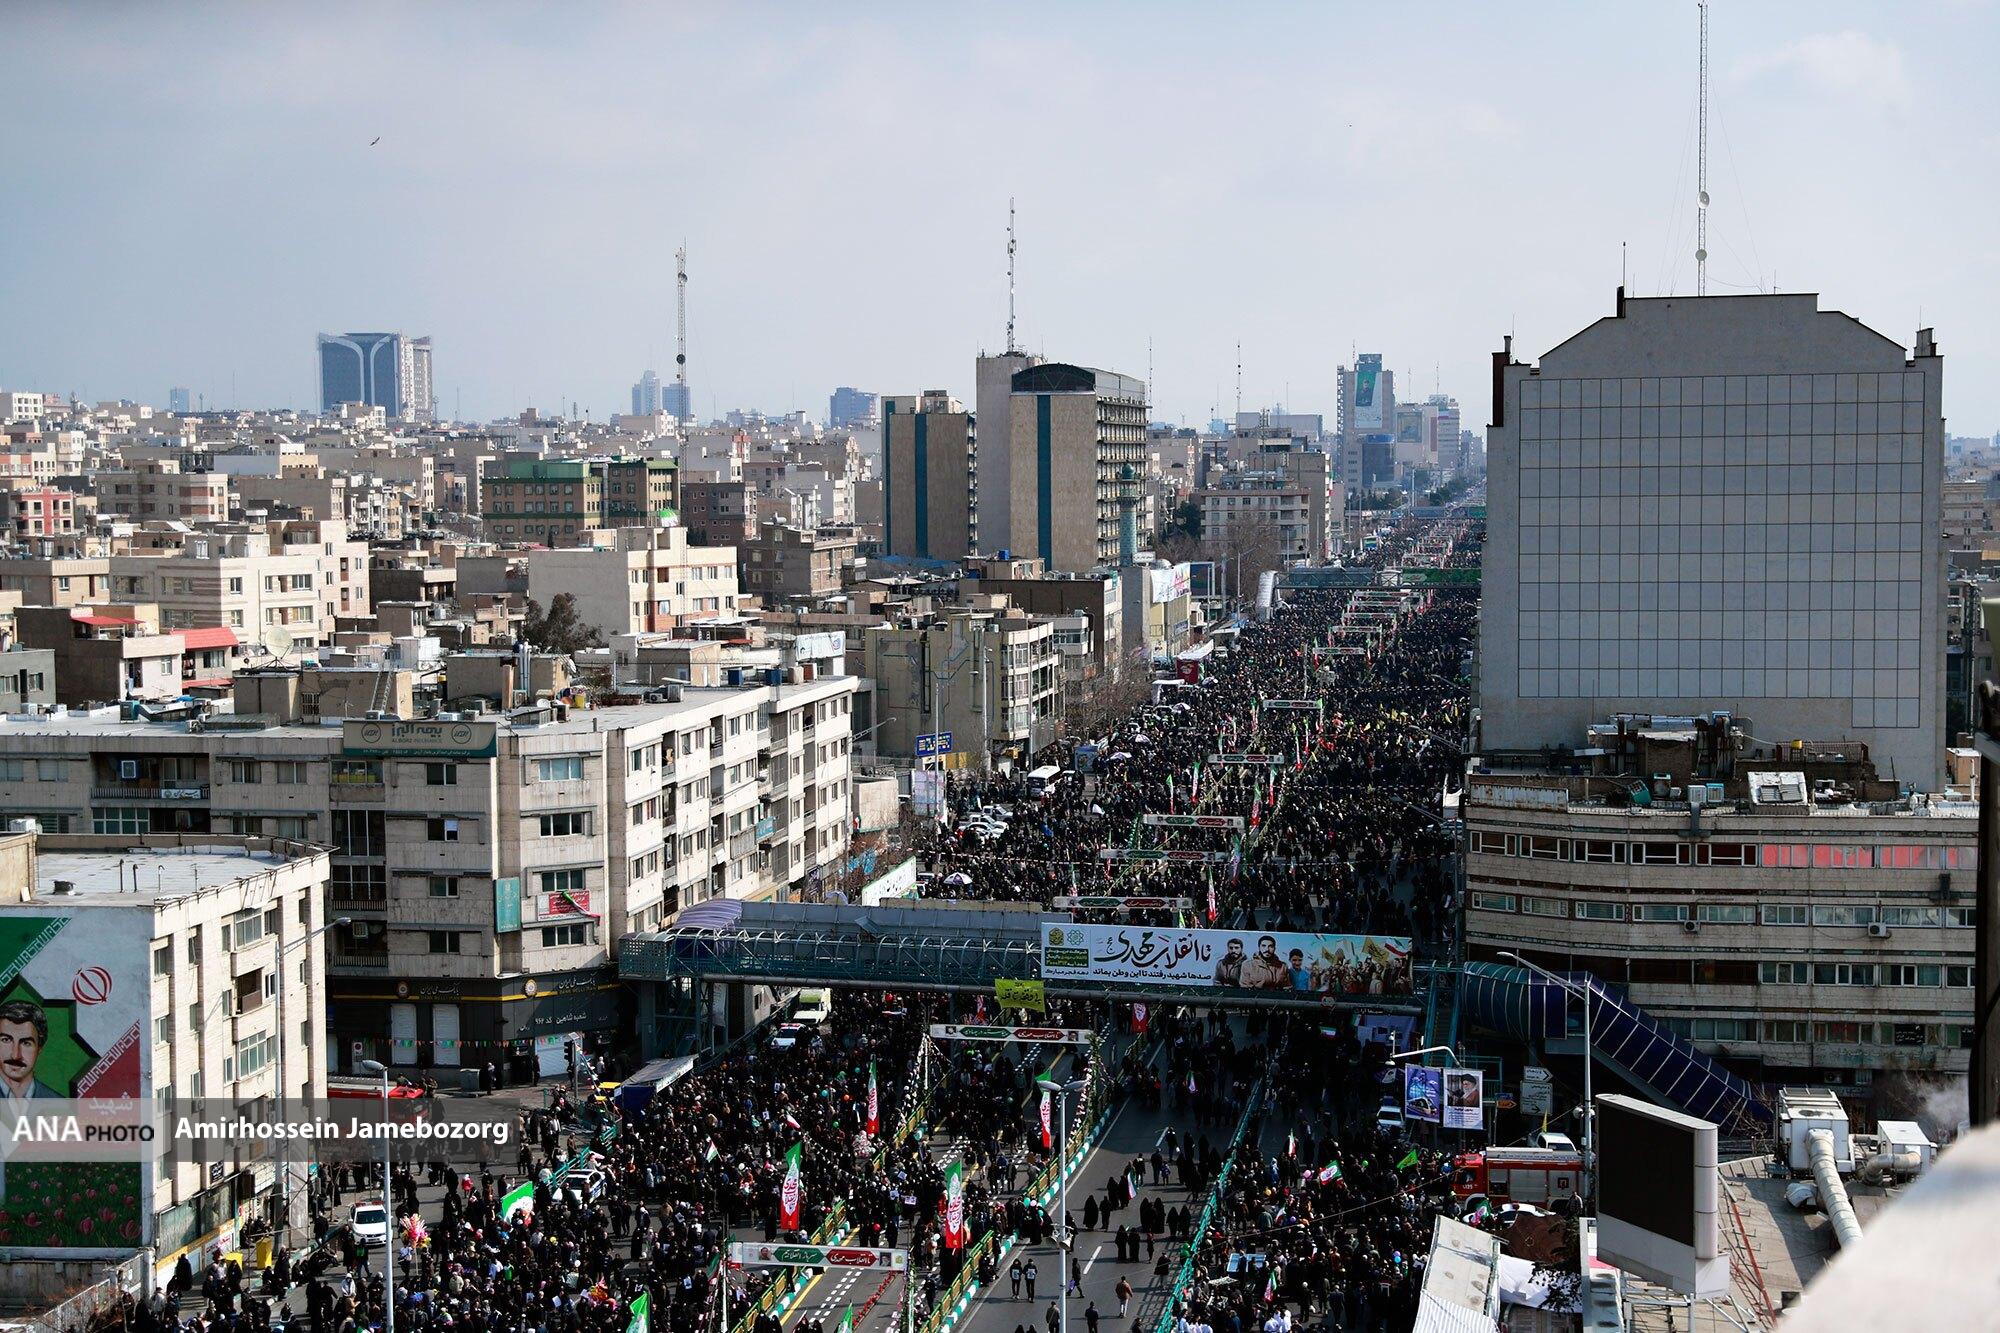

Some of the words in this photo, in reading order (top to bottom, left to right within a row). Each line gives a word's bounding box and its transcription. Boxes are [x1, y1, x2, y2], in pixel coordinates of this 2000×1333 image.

[391, 723, 415, 738] البرز
[417, 726, 443, 737] بیمه
[1094, 930, 1155, 963] مهدی
[1131, 933, 1199, 969] انقلاب
[1201, 943, 1211, 962] تا
[1093, 967, 1111, 976] بماند
[1112, 968, 1129, 977] وطن
[1129, 969, 1142, 977] این
[1142, 969, 1149, 977] تا
[1148, 971, 1166, 979] رفتند
[1167, 971, 1188, 979] شهید
[1188, 972, 1212, 980] صدها
[558, 978, 571, 989] ایران
[420, 986, 431, 995] ایران
[545, 1016, 553, 1024] کد
[574, 1012, 587, 1021] شعبه
[89, 1091, 133, 1115] شهید
[830, 1253, 845, 1263] مهدی
[845, 1253, 868, 1264] انقلاب
[867, 1253, 873, 1263] تا
